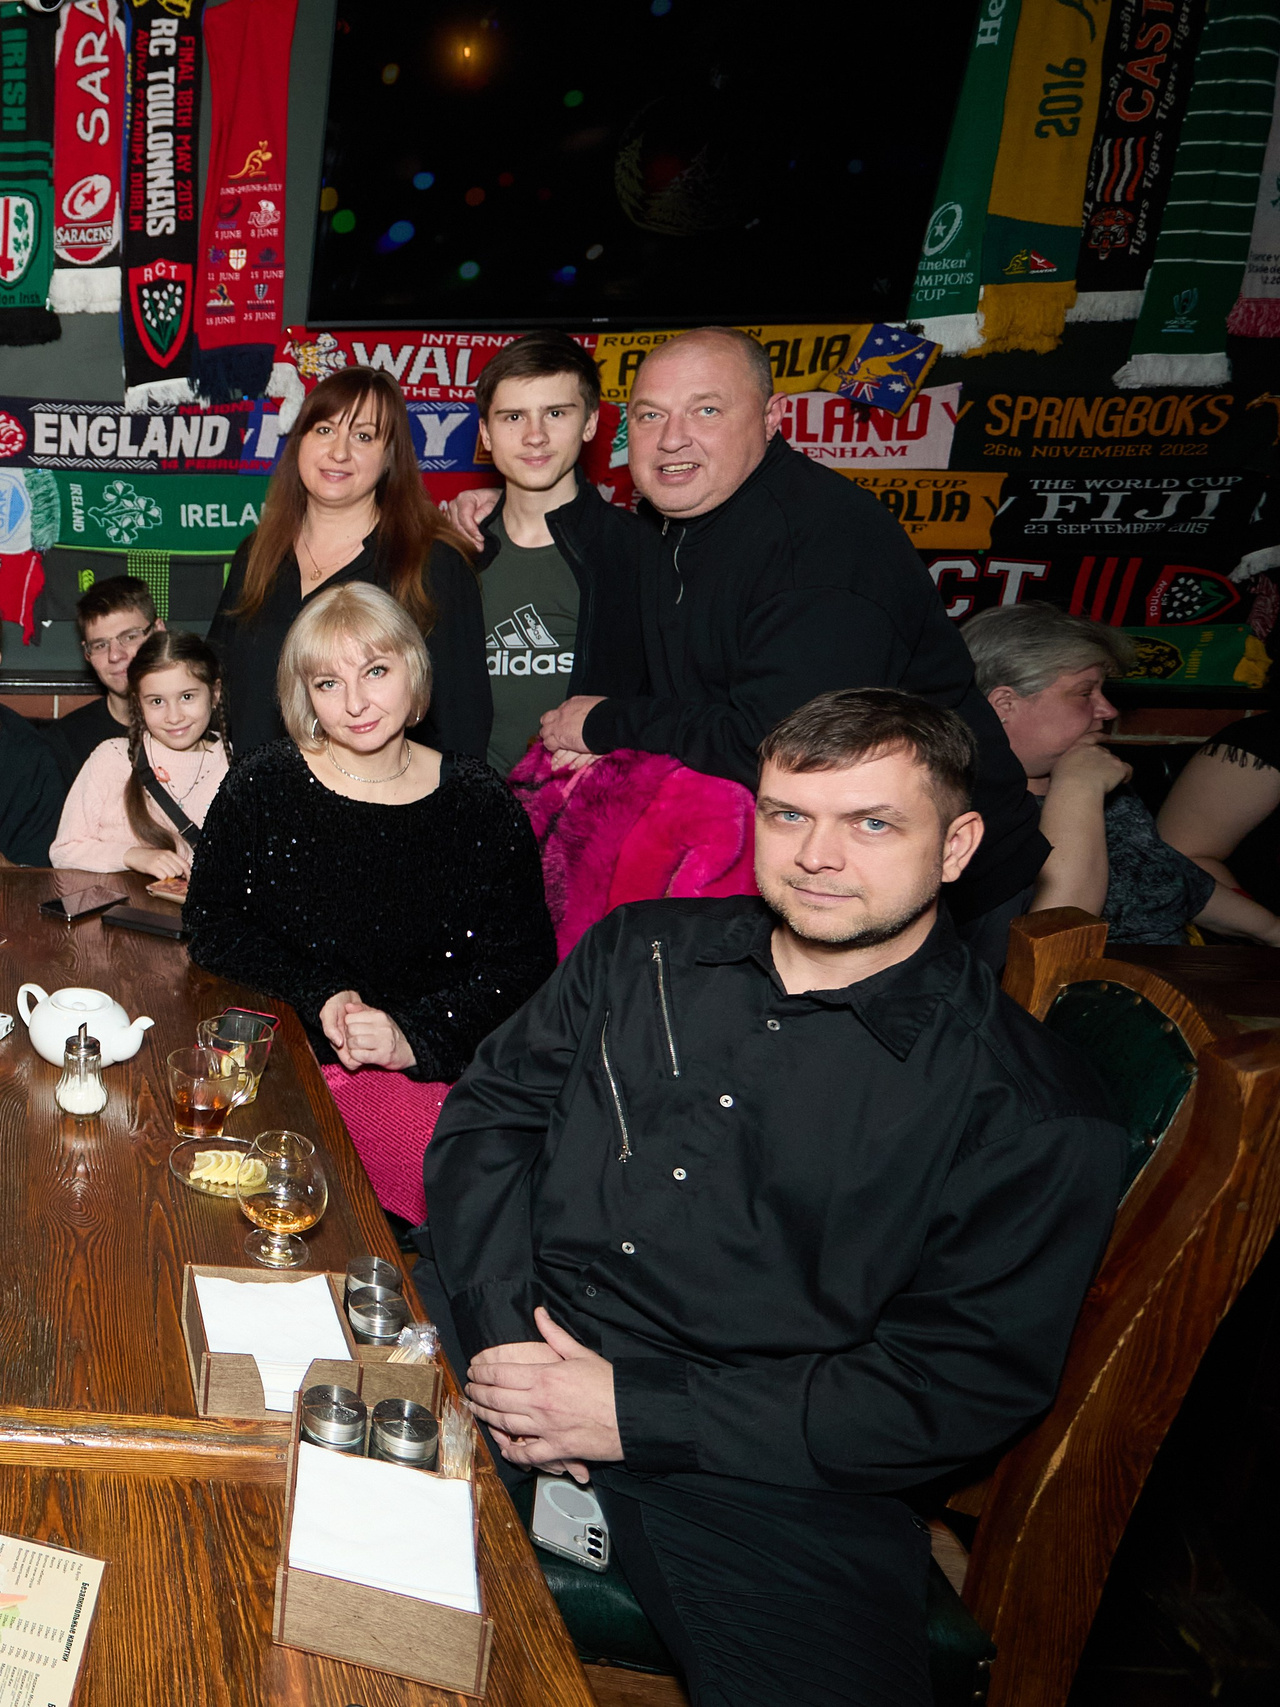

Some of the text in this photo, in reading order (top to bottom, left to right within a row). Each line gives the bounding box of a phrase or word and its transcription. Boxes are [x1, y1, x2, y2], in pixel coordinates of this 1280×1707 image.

[1, 27, 27, 132] IRISH
[177, 35, 197, 85] FINAL
[1034, 56, 1087, 139] 2016
[146, 17, 179, 238] RC TOULONNAIS
[175, 133, 194, 174] MAY
[1142, 130, 1164, 190] Tigers
[176, 179, 196, 222] 2013
[56, 224, 113, 246] SARACENS
[257, 228, 279, 239] JUNE
[1128, 199, 1150, 256] Tigers
[142, 261, 178, 282] RCT
[263, 269, 285, 281] JUNE
[915, 287, 946, 302] CUP
[255, 312, 277, 323] JUNE
[32, 412, 231, 459] ENGLAND
[983, 393, 1234, 440] SPRINGBOKS
[1030, 443, 1153, 459] NOVEMBER
[1159, 443, 1209, 457] 2022
[915, 479, 968, 489] CUP
[1029, 475, 1244, 490] THE WORLD CUP
[68, 482, 86, 534] IRELAND
[1029, 488, 1232, 523] FIJI
[1023, 522, 1211, 536] 23 SEPTEMBER 2015
[1149, 580, 1169, 618] TOULON
[69, 1582, 89, 1634] Безалкогольные
